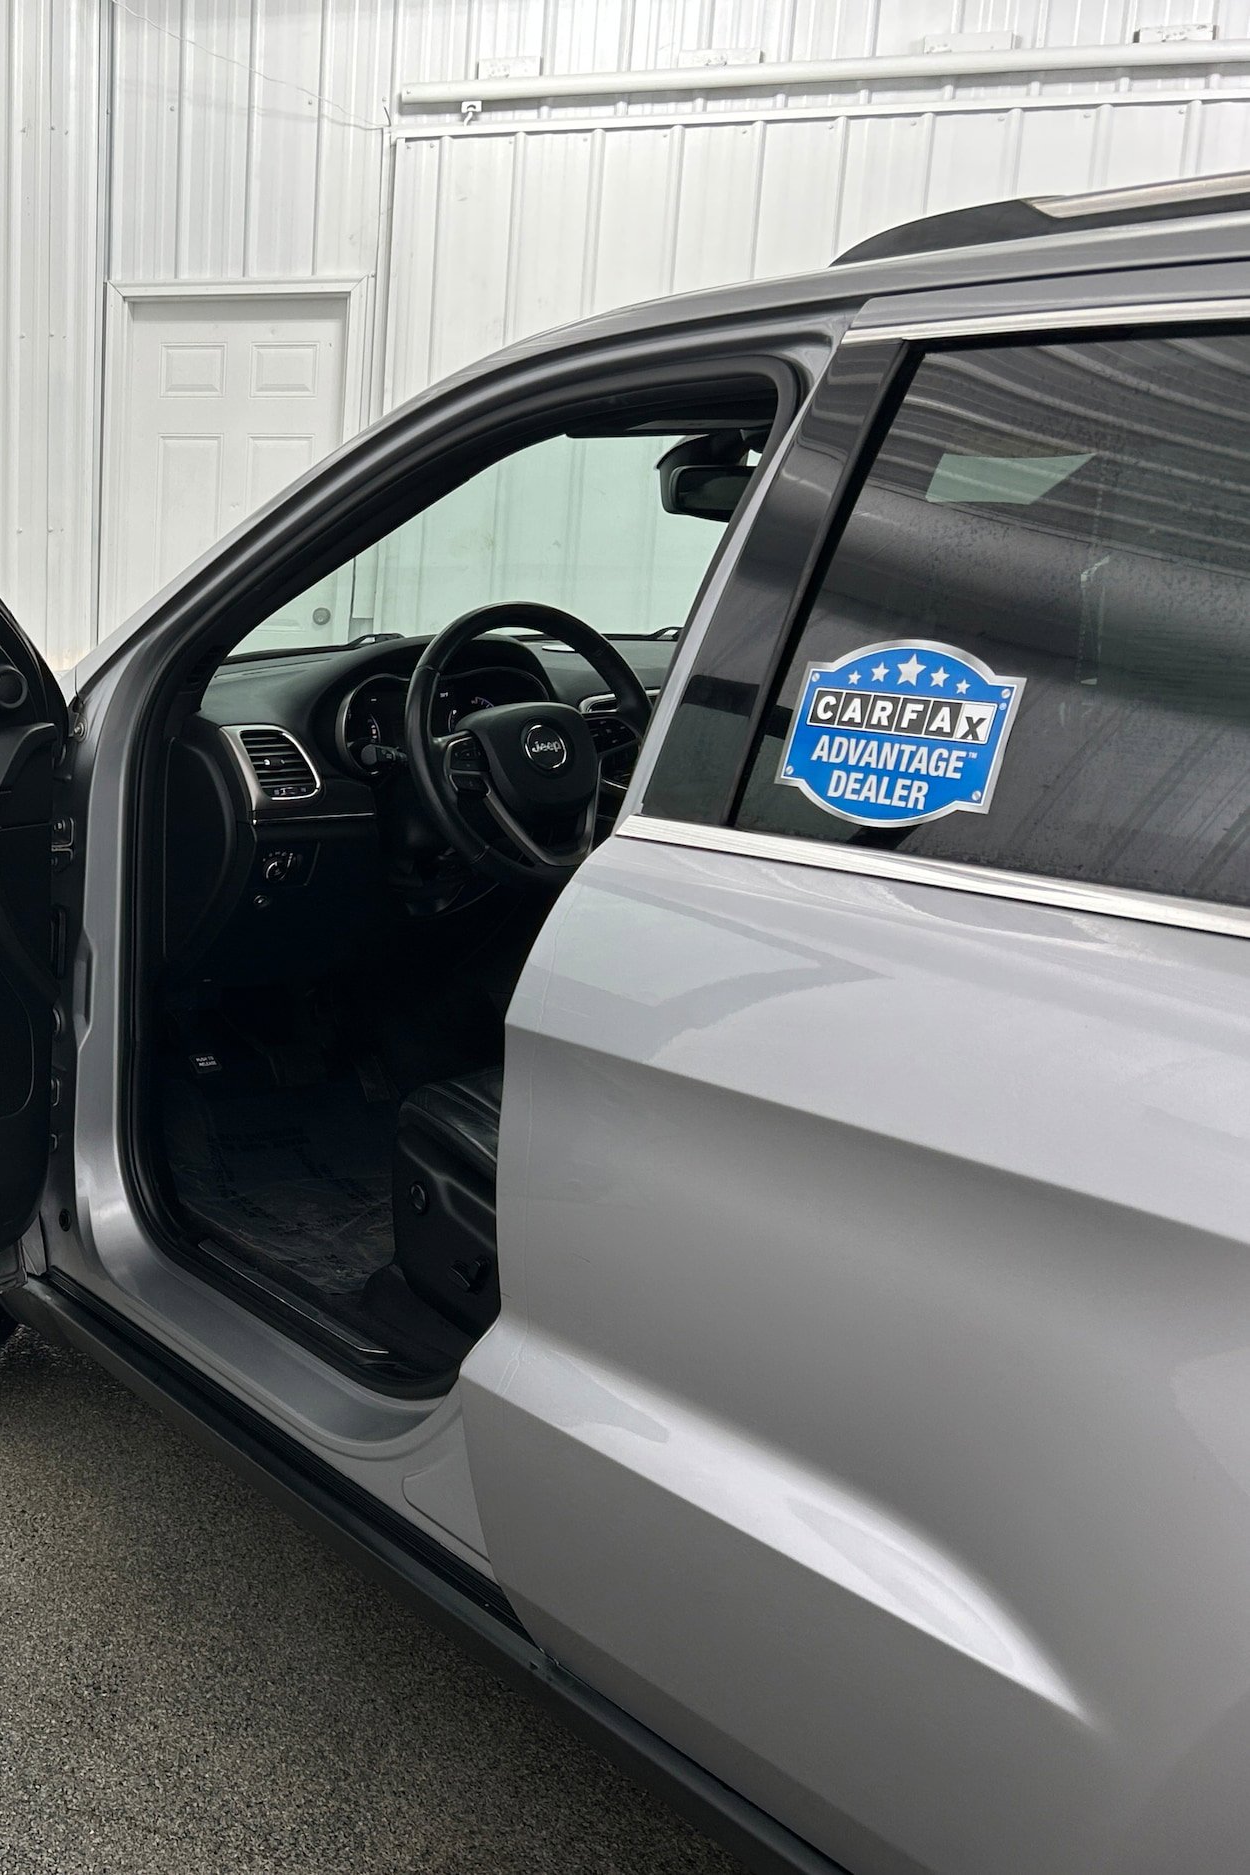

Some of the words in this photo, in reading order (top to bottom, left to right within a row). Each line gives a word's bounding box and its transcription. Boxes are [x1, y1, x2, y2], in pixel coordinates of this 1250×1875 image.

[815, 694, 987, 741] CARFAX
[531, 740, 562, 753] Jeep
[810, 734, 967, 780] ADVANTAGE
[826, 769, 930, 811] DEALER
